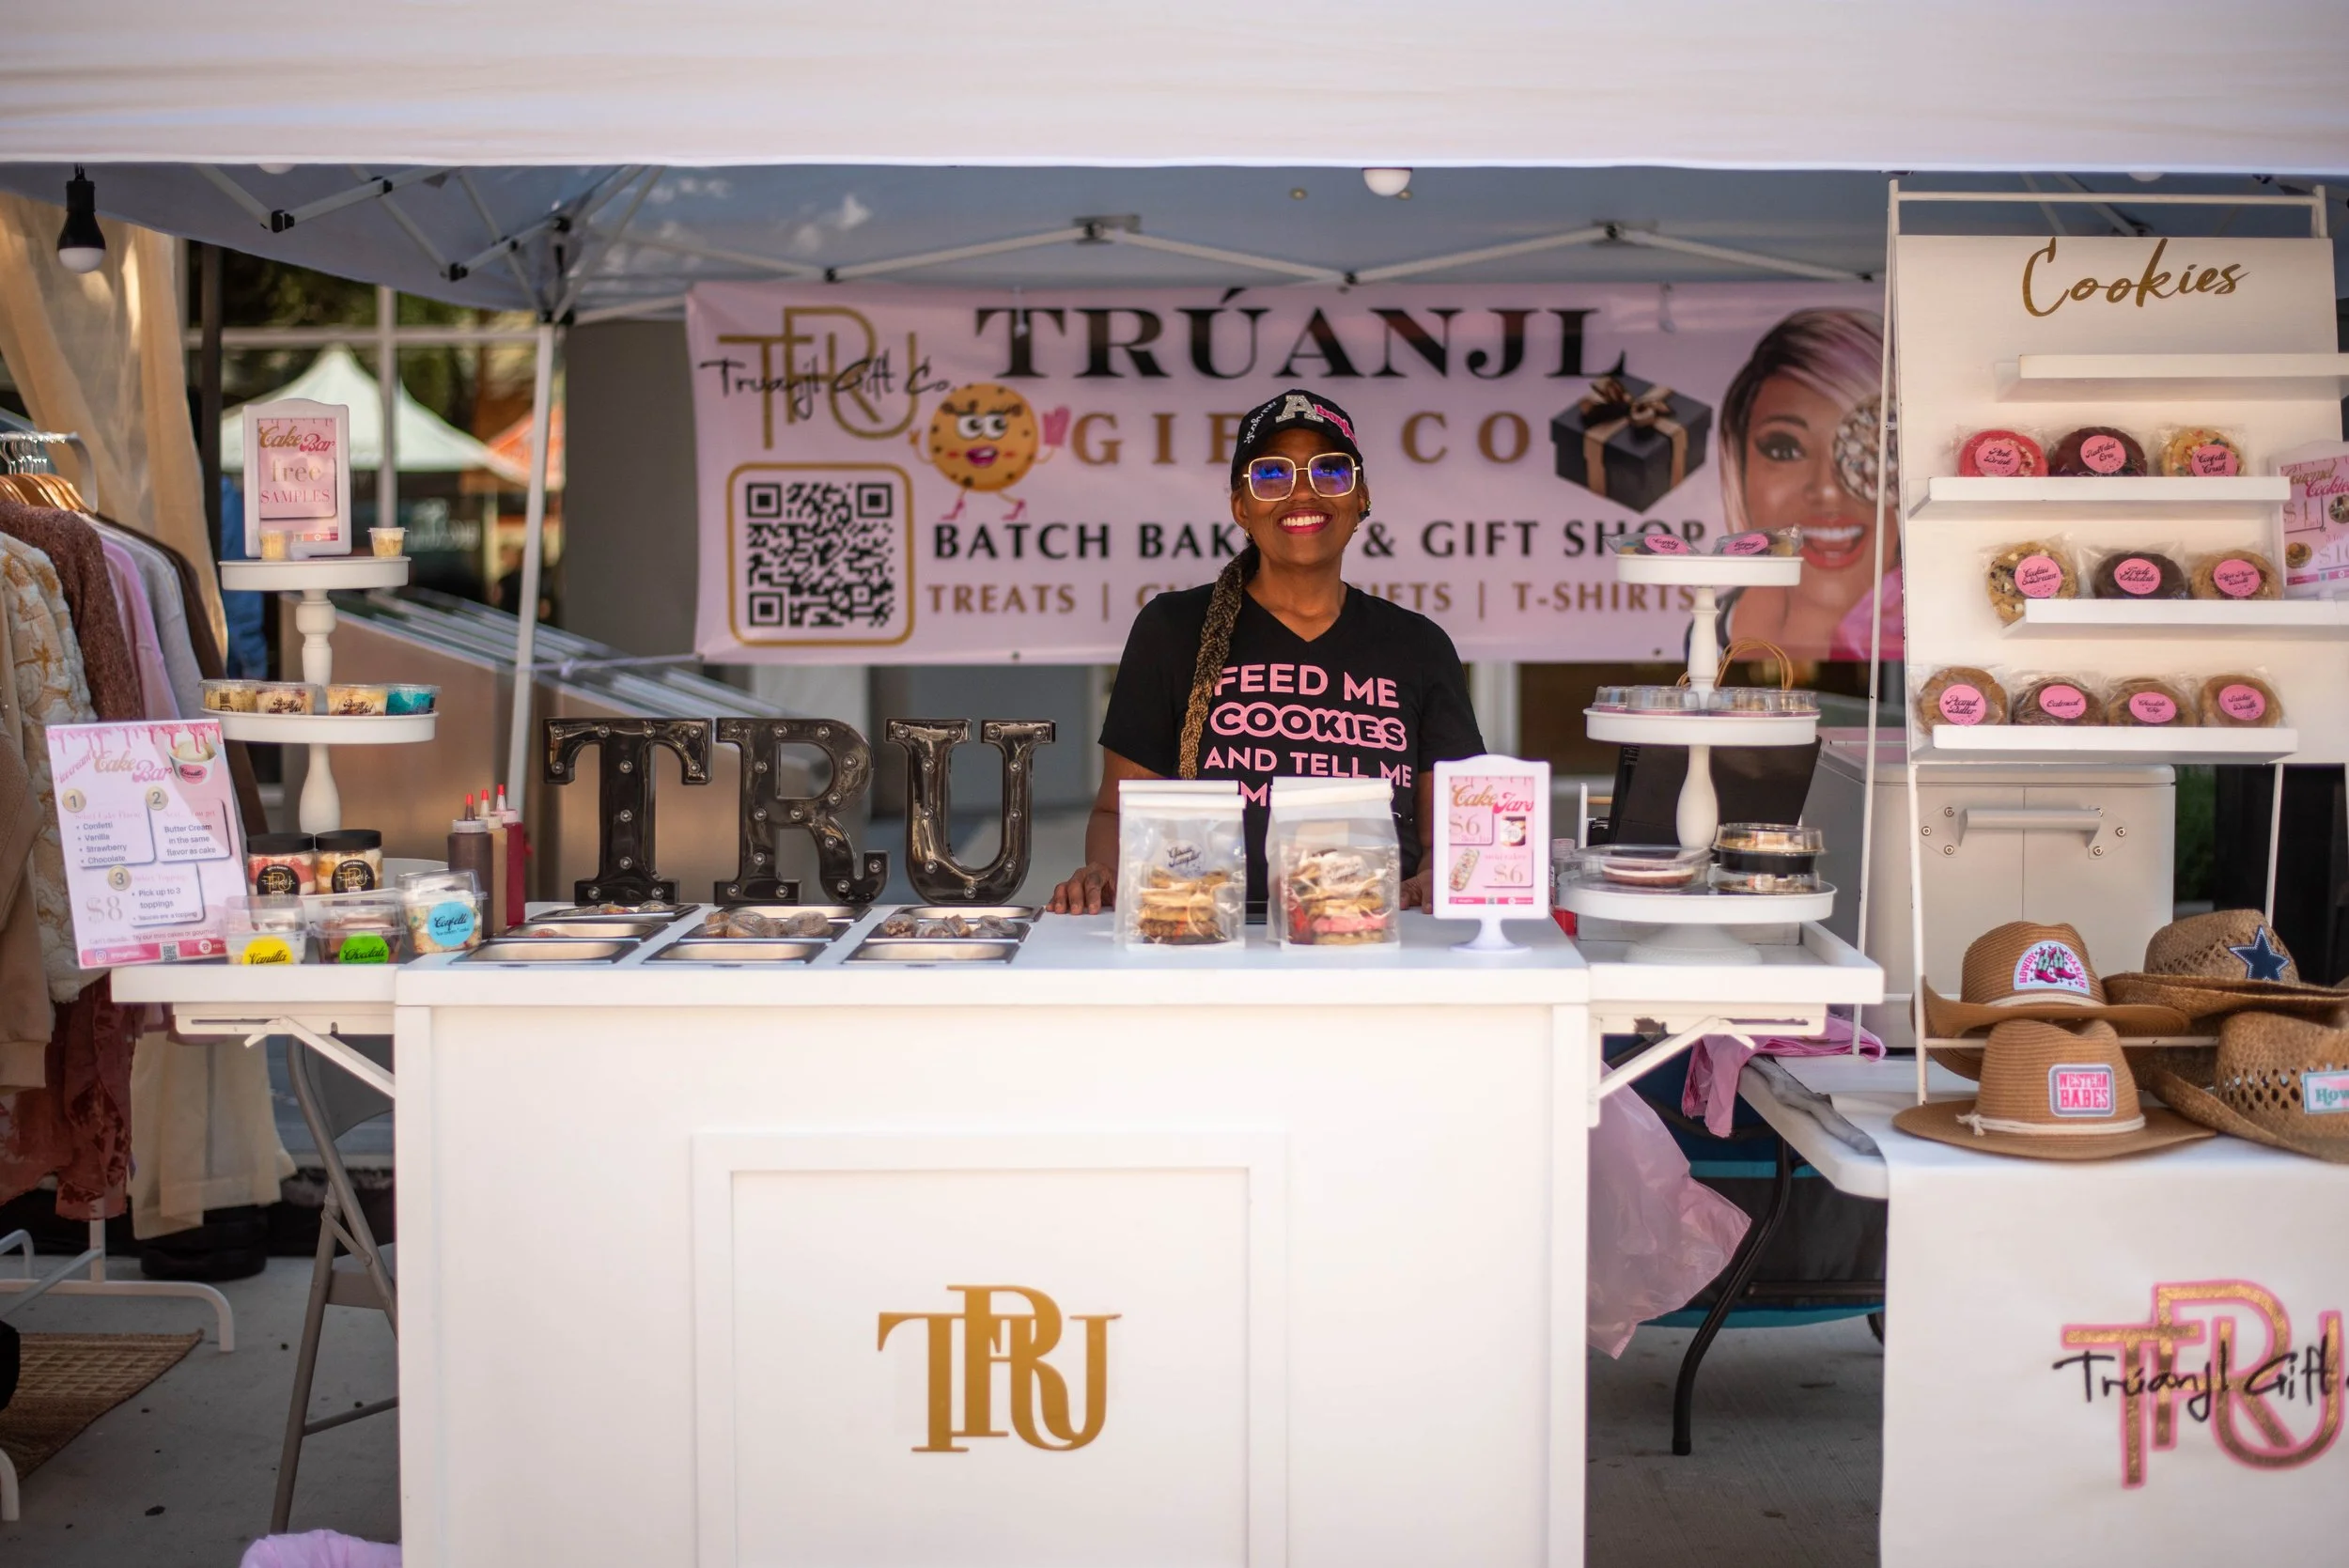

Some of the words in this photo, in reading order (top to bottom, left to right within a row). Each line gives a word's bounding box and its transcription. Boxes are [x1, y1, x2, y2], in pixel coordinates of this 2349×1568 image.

[2021, 237, 2251, 318] Cookies
[975, 288, 1626, 380] TRÚANJL
[258, 425, 303, 449] Cake
[299, 433, 336, 453] Bar
[1071, 411, 1240, 466] GIF
[1401, 411, 1531, 466] CO
[2196, 451, 2227, 466] Confetti
[271, 458, 321, 483] free
[2306, 475, 2349, 498] Cookie
[260, 489, 332, 504] SAMPLES
[934, 522, 1111, 559] BATCH
[1138, 522, 1237, 559] BAK
[1363, 520, 1396, 558] &
[1422, 520, 1539, 557] GIFT
[926, 584, 1075, 614] TREATS
[1512, 582, 1695, 613] T-SHIRTS
[1214, 663, 1329, 696] FEED
[1344, 671, 1400, 709] ME
[2046, 697, 2082, 707] Oatmeal
[1210, 702, 1408, 752] COOKIES
[92, 751, 137, 773] Cake
[132, 760, 173, 783] Bar
[1204, 746, 1278, 781] AND
[1289, 752, 1370, 779] TELL
[1379, 760, 1412, 788] ME
[70, 795, 78, 808] 1
[151, 791, 163, 805] 2
[1452, 784, 1498, 808] Cake
[1492, 792, 1534, 815] Jars
[543, 717, 1056, 907] TRU
[83, 822, 114, 831] Confetti
[163, 824, 187, 834] Butter
[188, 823, 213, 832] Cream
[85, 832, 111, 842] Vanilla
[168, 836, 176, 845] in
[176, 834, 190, 844] the
[190, 834, 210, 845] same
[86, 844, 128, 854] Strawberry
[166, 846, 188, 857] flavor
[199, 846, 216, 855] cake
[87, 855, 127, 865] Chocolate
[114, 872, 125, 886] 3
[138, 889, 154, 897] Pick
[155, 889, 166, 898] up
[86, 894, 123, 924] $8
[139, 899, 175, 910] toppings
[433, 912, 468, 931] Confetti
[166, 930, 185, 939] cakes
[248, 949, 288, 965] Vanilla
[344, 946, 385, 962] Chocolate
[2018, 952, 2037, 984] HOWDY
[2059, 1073, 2108, 1088] WESTERN
[2059, 1089, 2108, 1109] BABES
[876, 1283, 1122, 1452] TRU
